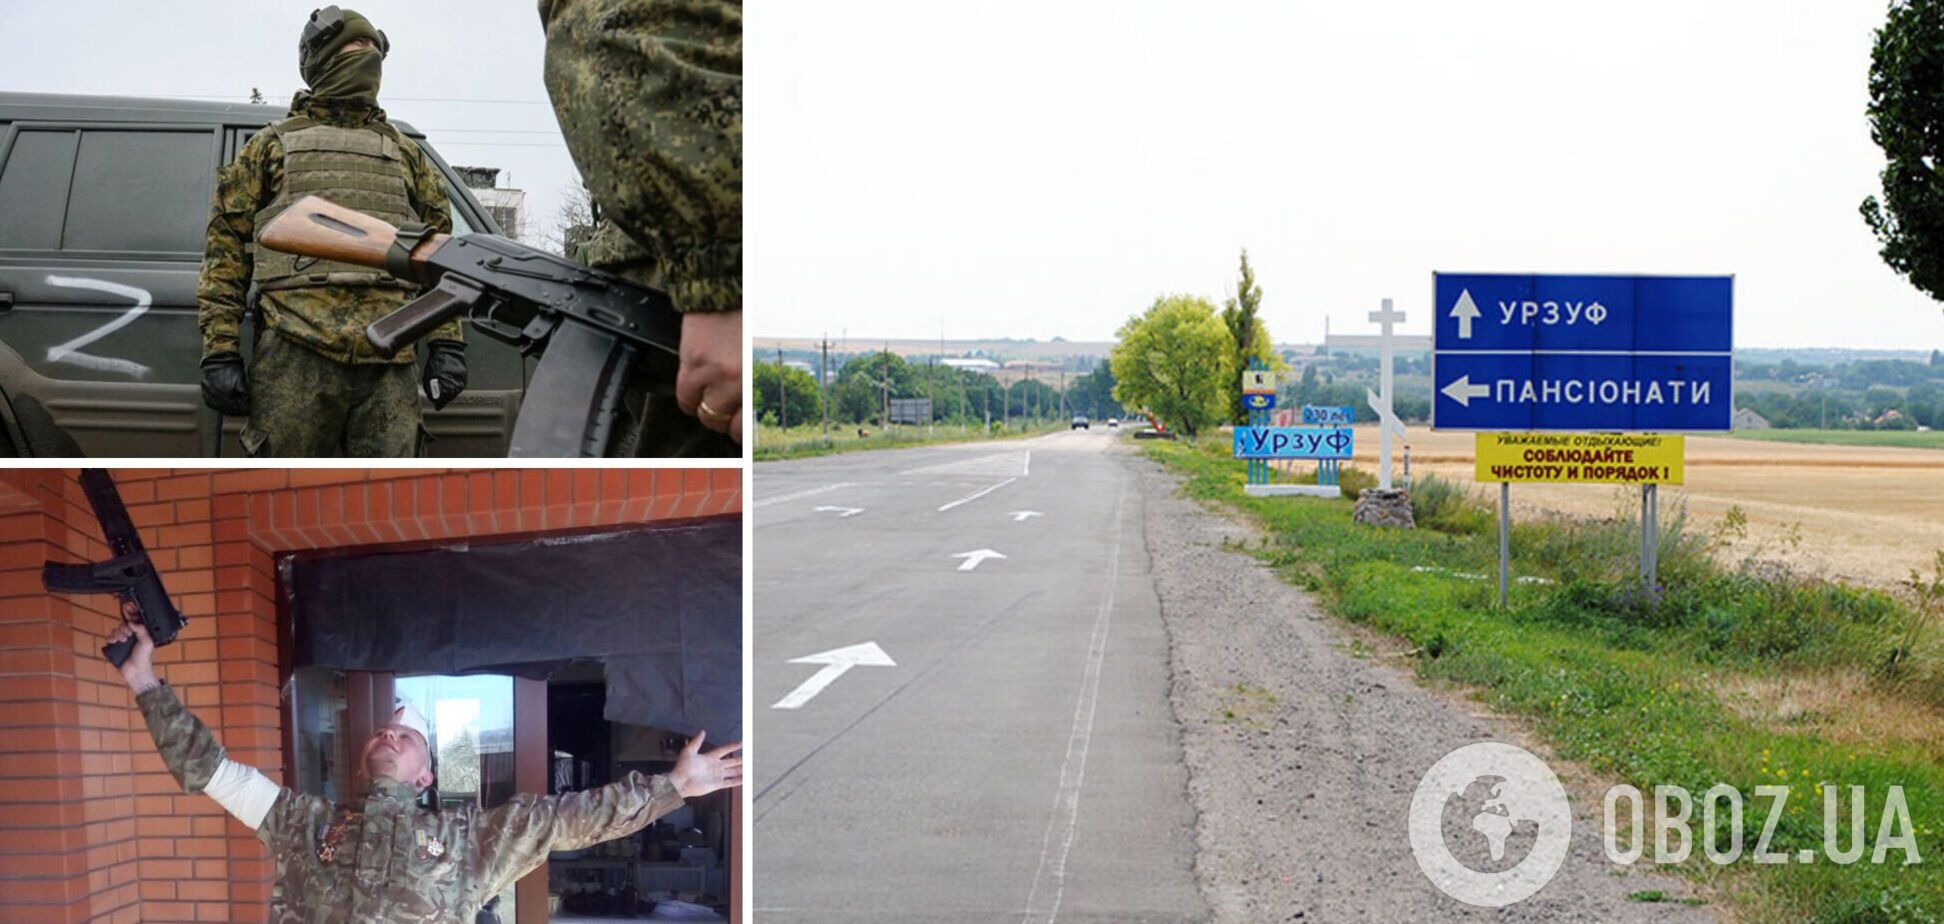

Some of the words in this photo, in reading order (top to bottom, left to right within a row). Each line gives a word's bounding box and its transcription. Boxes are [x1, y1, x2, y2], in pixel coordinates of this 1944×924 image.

[1499, 301, 1607, 325] УРЗУФ
[46, 275, 152, 378] Z
[1496, 380, 1711, 404] ПАНСІОНАТИ
[1252, 429, 1350, 453] Урзуф
[1497, 436, 1569, 446] УВАЖАЕМЫЕ
[1523, 448, 1634, 464] СОБЛЮДАЙТЕ
[1491, 466, 1561, 478] ЧИСТОТУ
[1567, 467, 1578, 478] И
[1583, 467, 1659, 481] ПОРЯДОК
